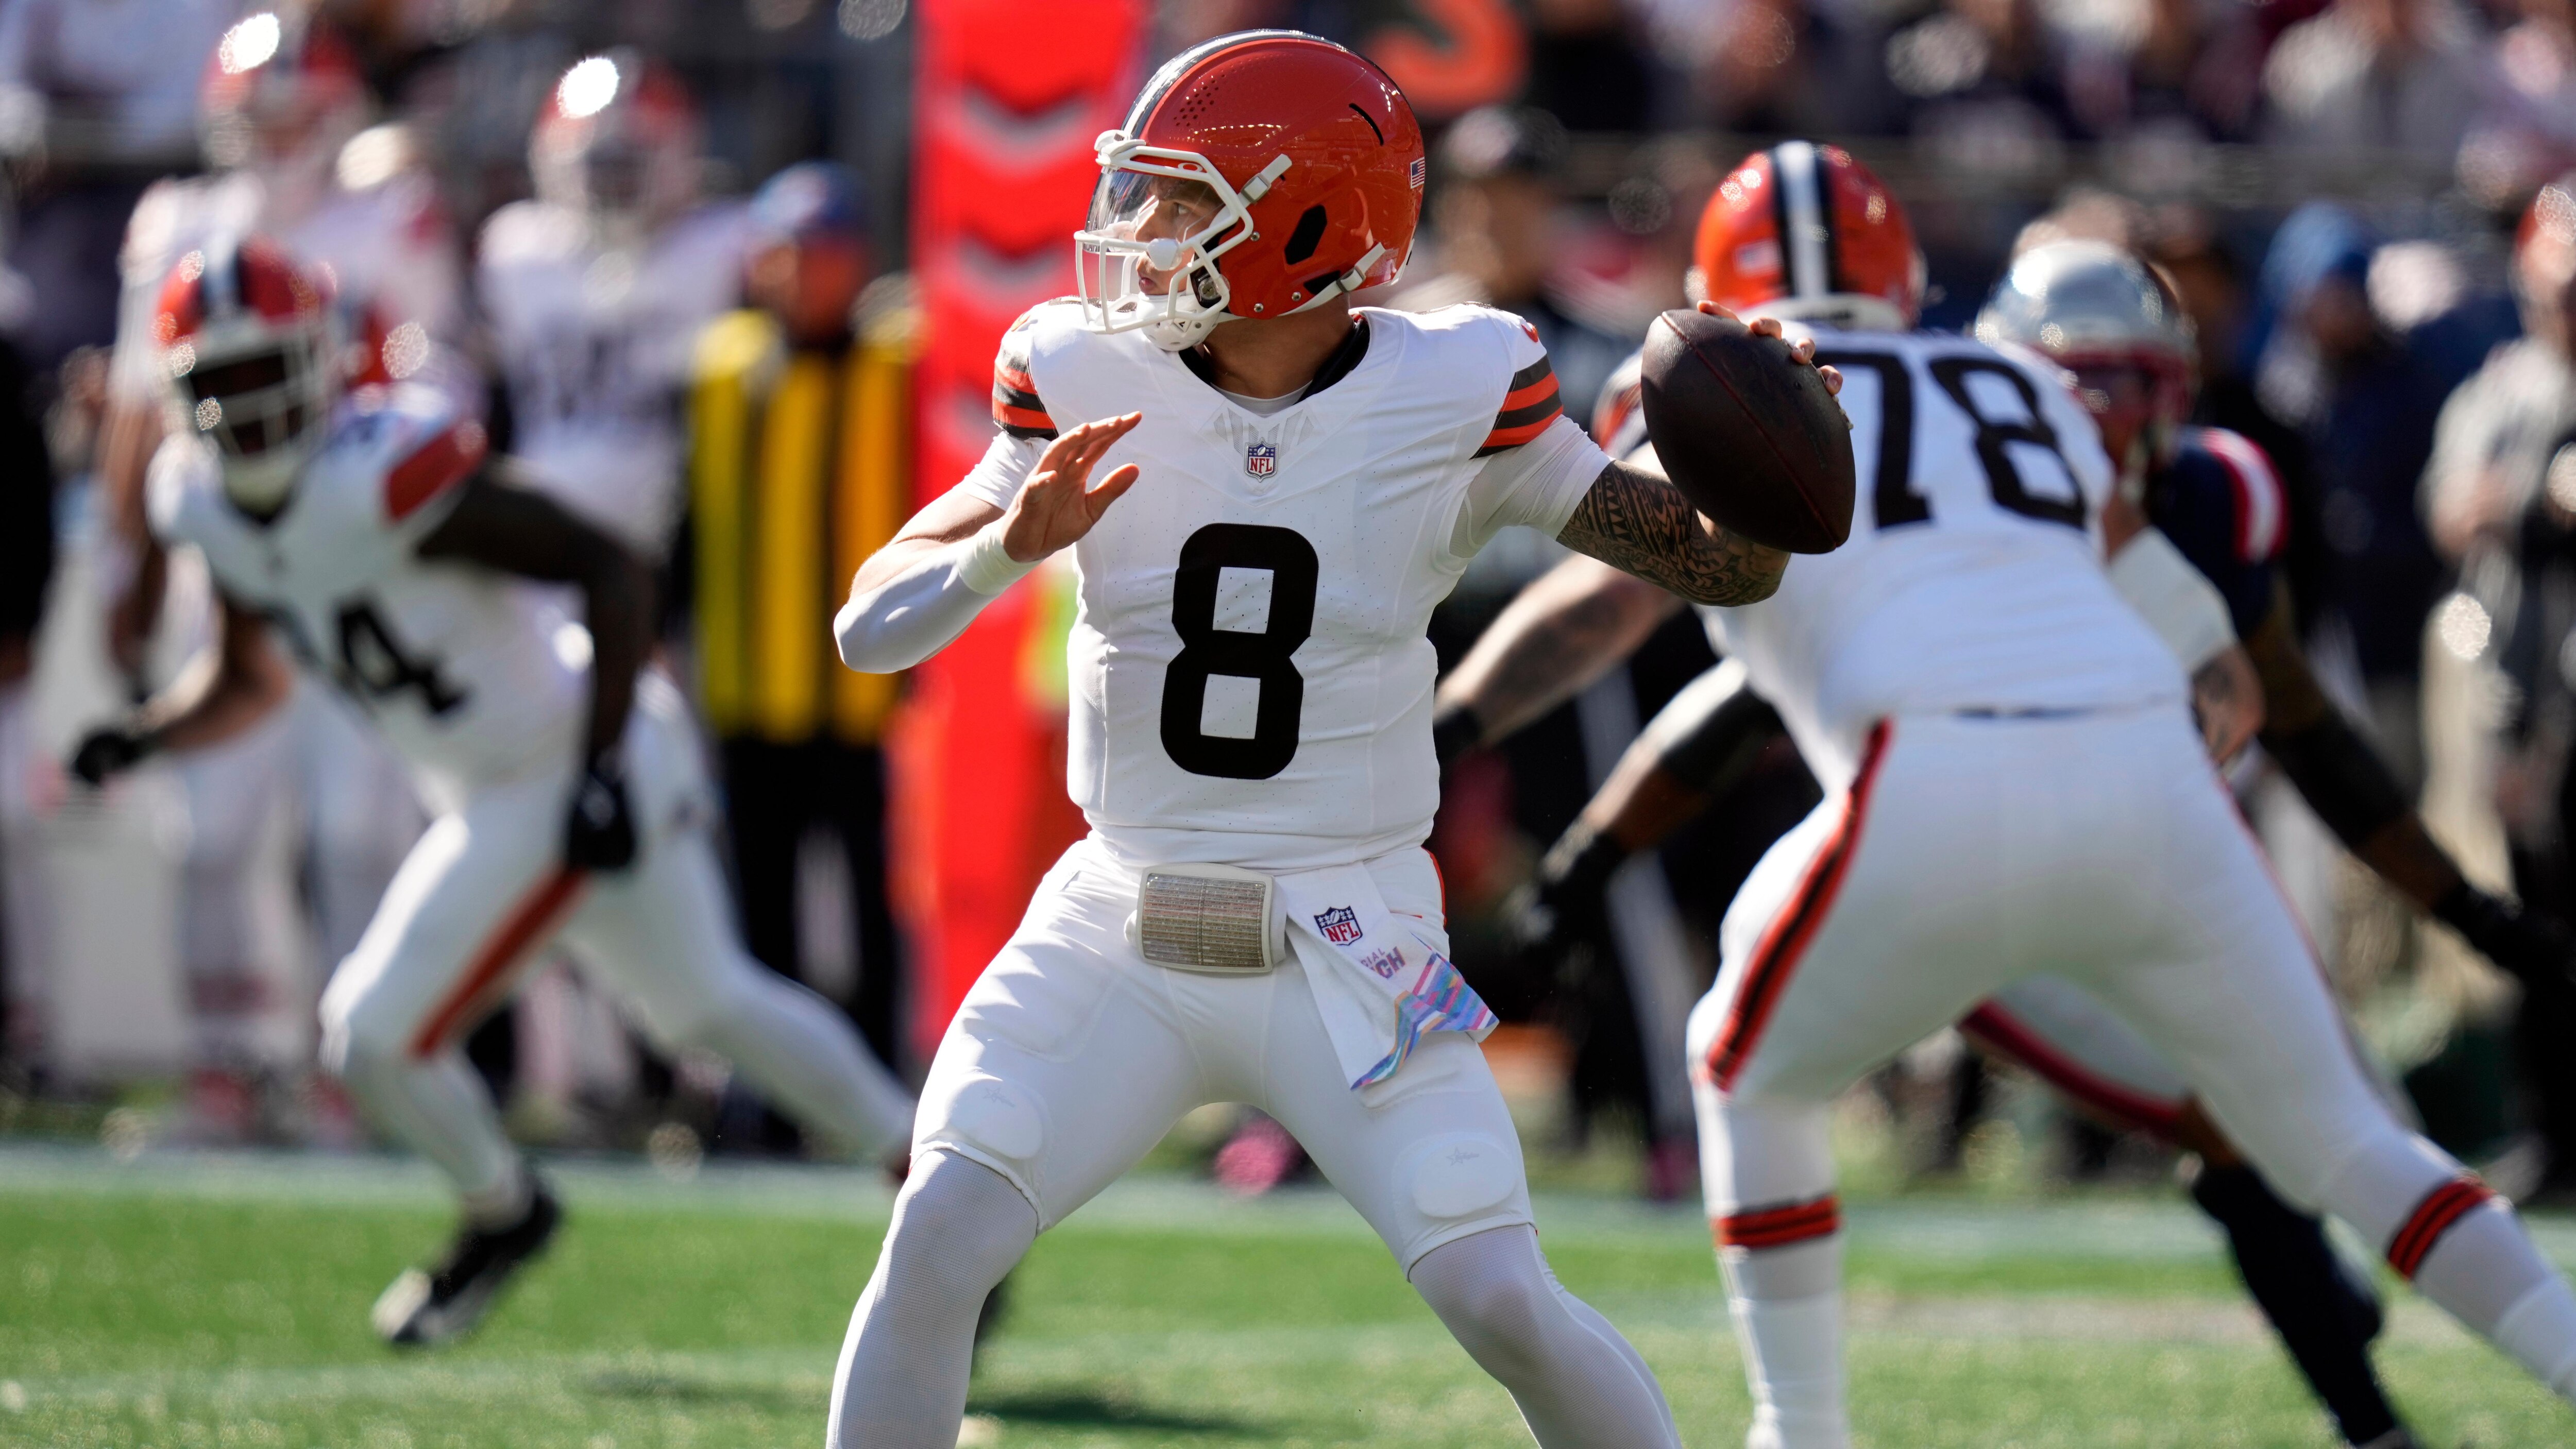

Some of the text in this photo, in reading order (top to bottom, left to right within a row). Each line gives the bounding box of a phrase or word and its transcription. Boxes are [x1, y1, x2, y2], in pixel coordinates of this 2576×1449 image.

[1250, 457, 1273, 474] NFL
[1814, 352, 2089, 531] 78
[296, 585, 477, 721] 4
[1160, 523, 1319, 780] 8
[1325, 922, 1360, 942] NFL
[1371, 946, 1405, 979] CH
